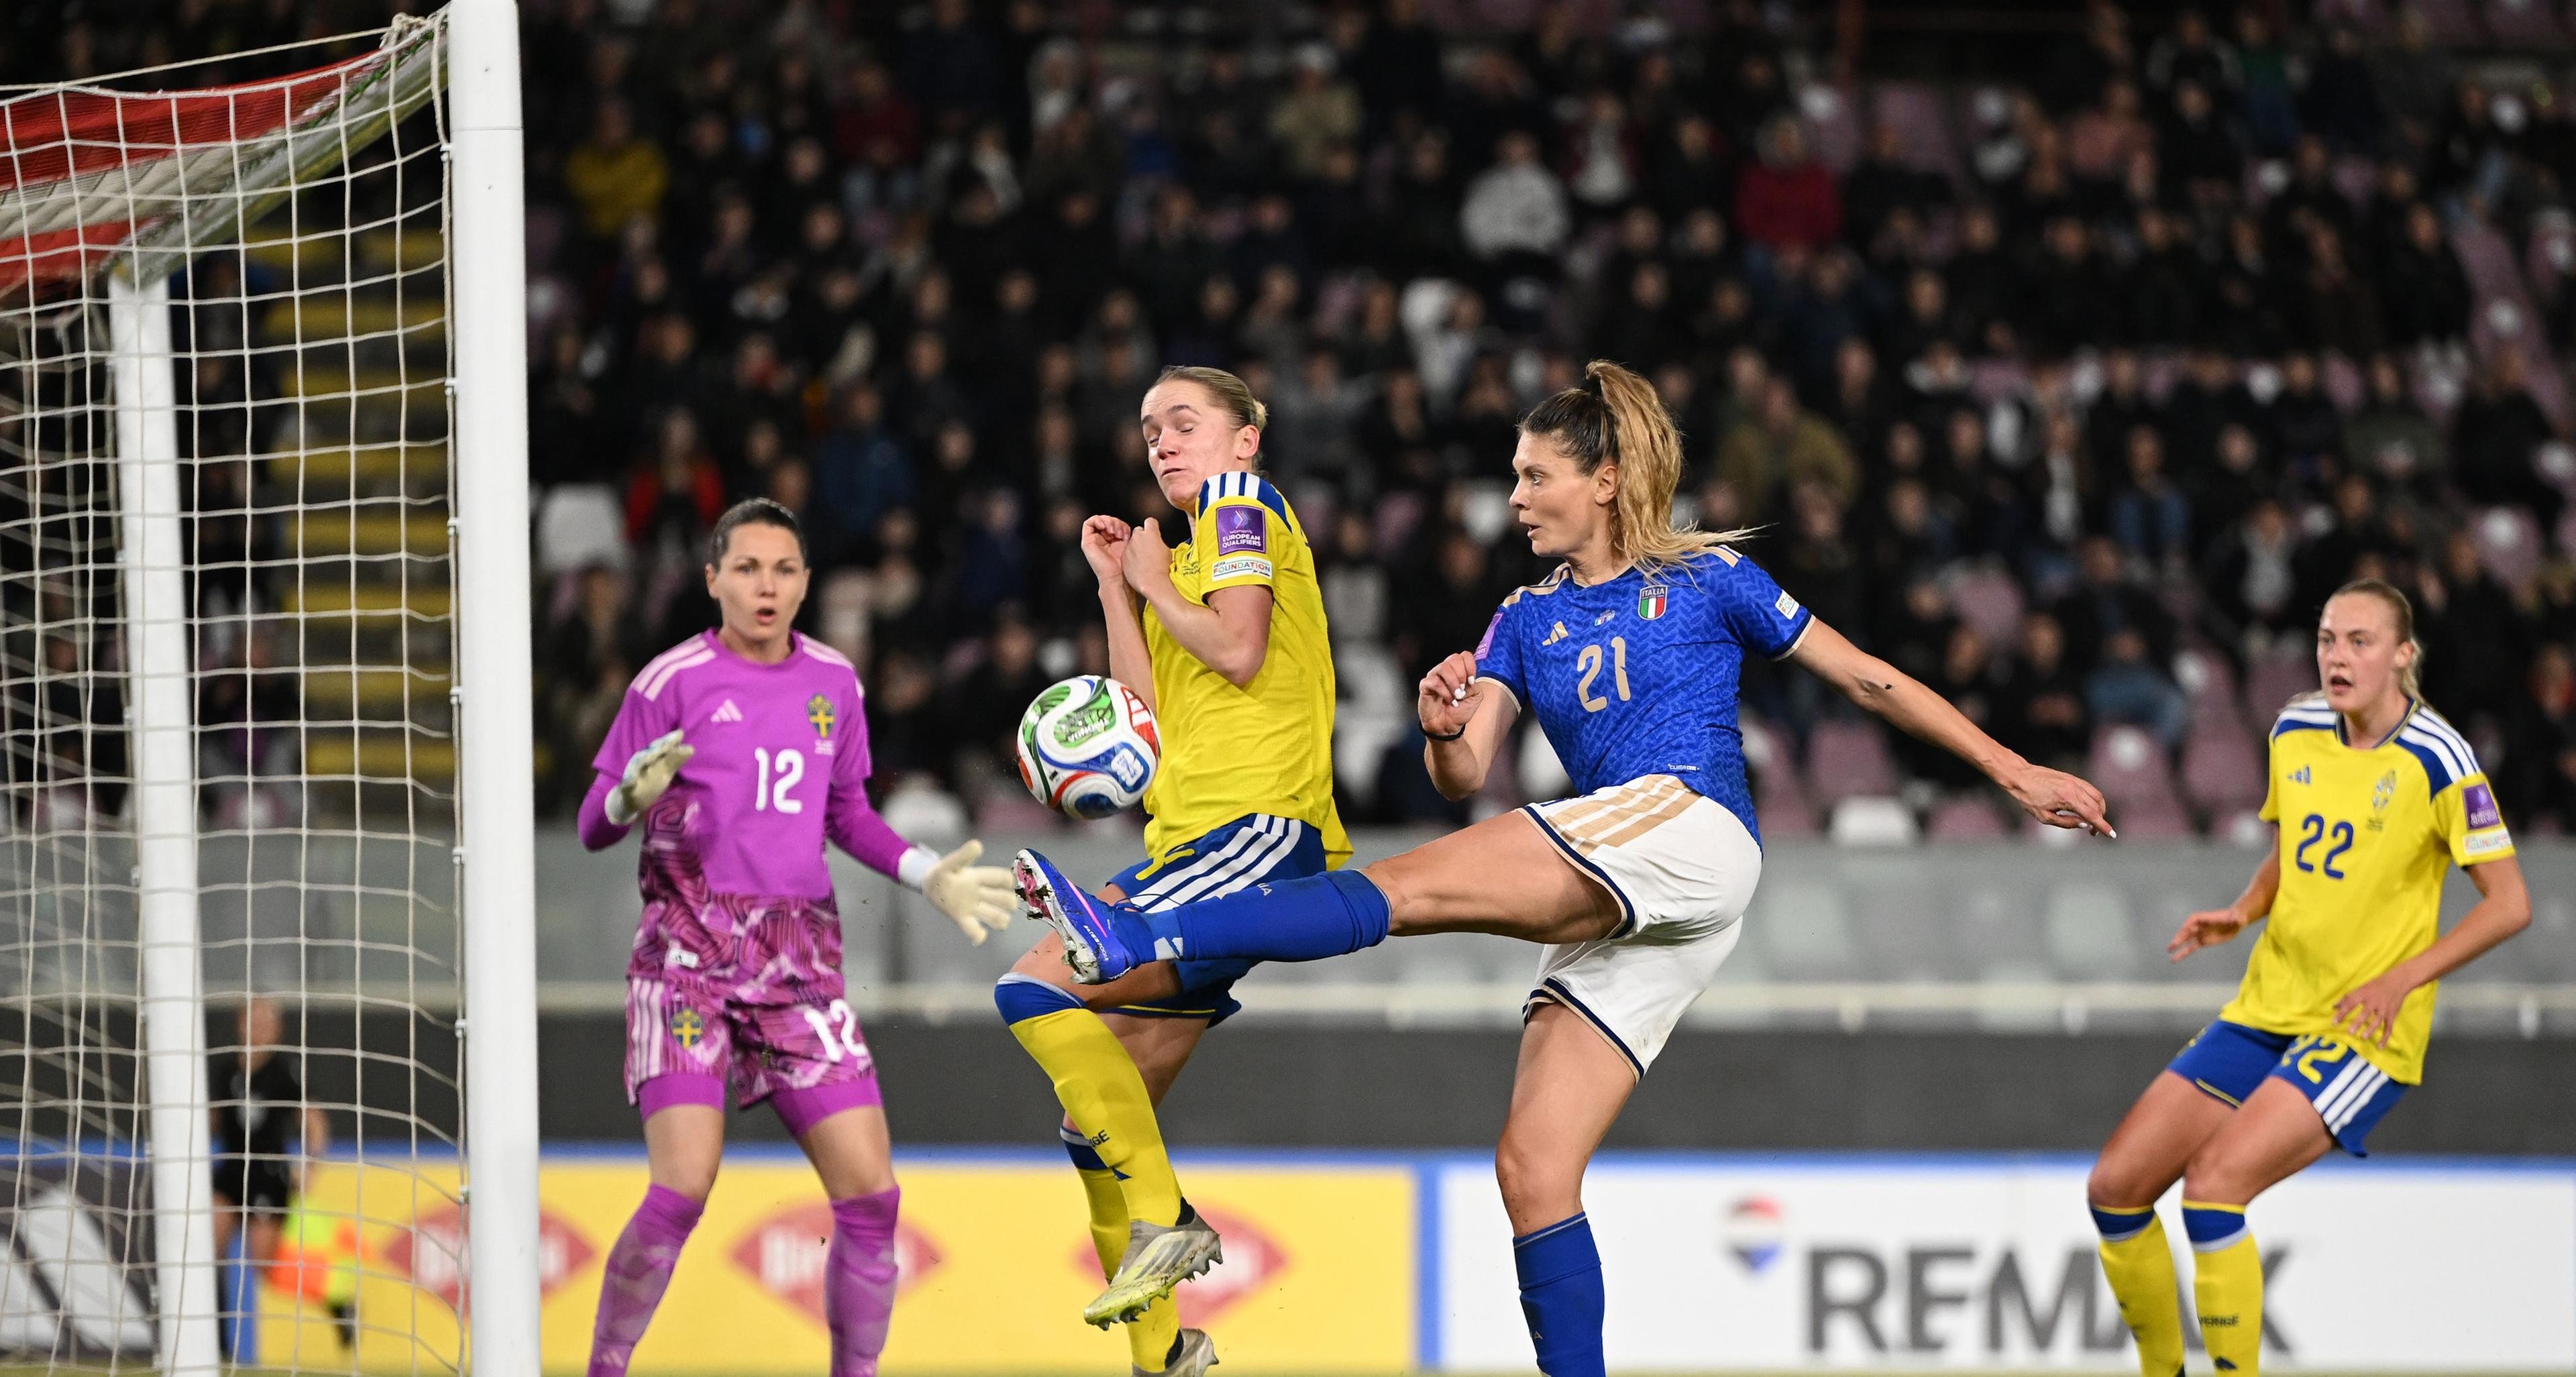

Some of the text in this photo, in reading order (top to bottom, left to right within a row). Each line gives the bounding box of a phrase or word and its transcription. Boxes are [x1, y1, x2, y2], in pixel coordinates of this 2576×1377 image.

[1213, 562, 1271, 575] FOUNDATION
[1222, 534, 1260, 543] EUROPEAN
[1222, 539, 1261, 548] QUALIFIERS
[1642, 588, 1665, 597] ITALIA
[1577, 636, 1631, 712] 21
[754, 746, 804, 814] 12
[2296, 814, 2354, 879] 22
[804, 998, 868, 1062] 12
[1807, 1246, 2292, 1354] REM
